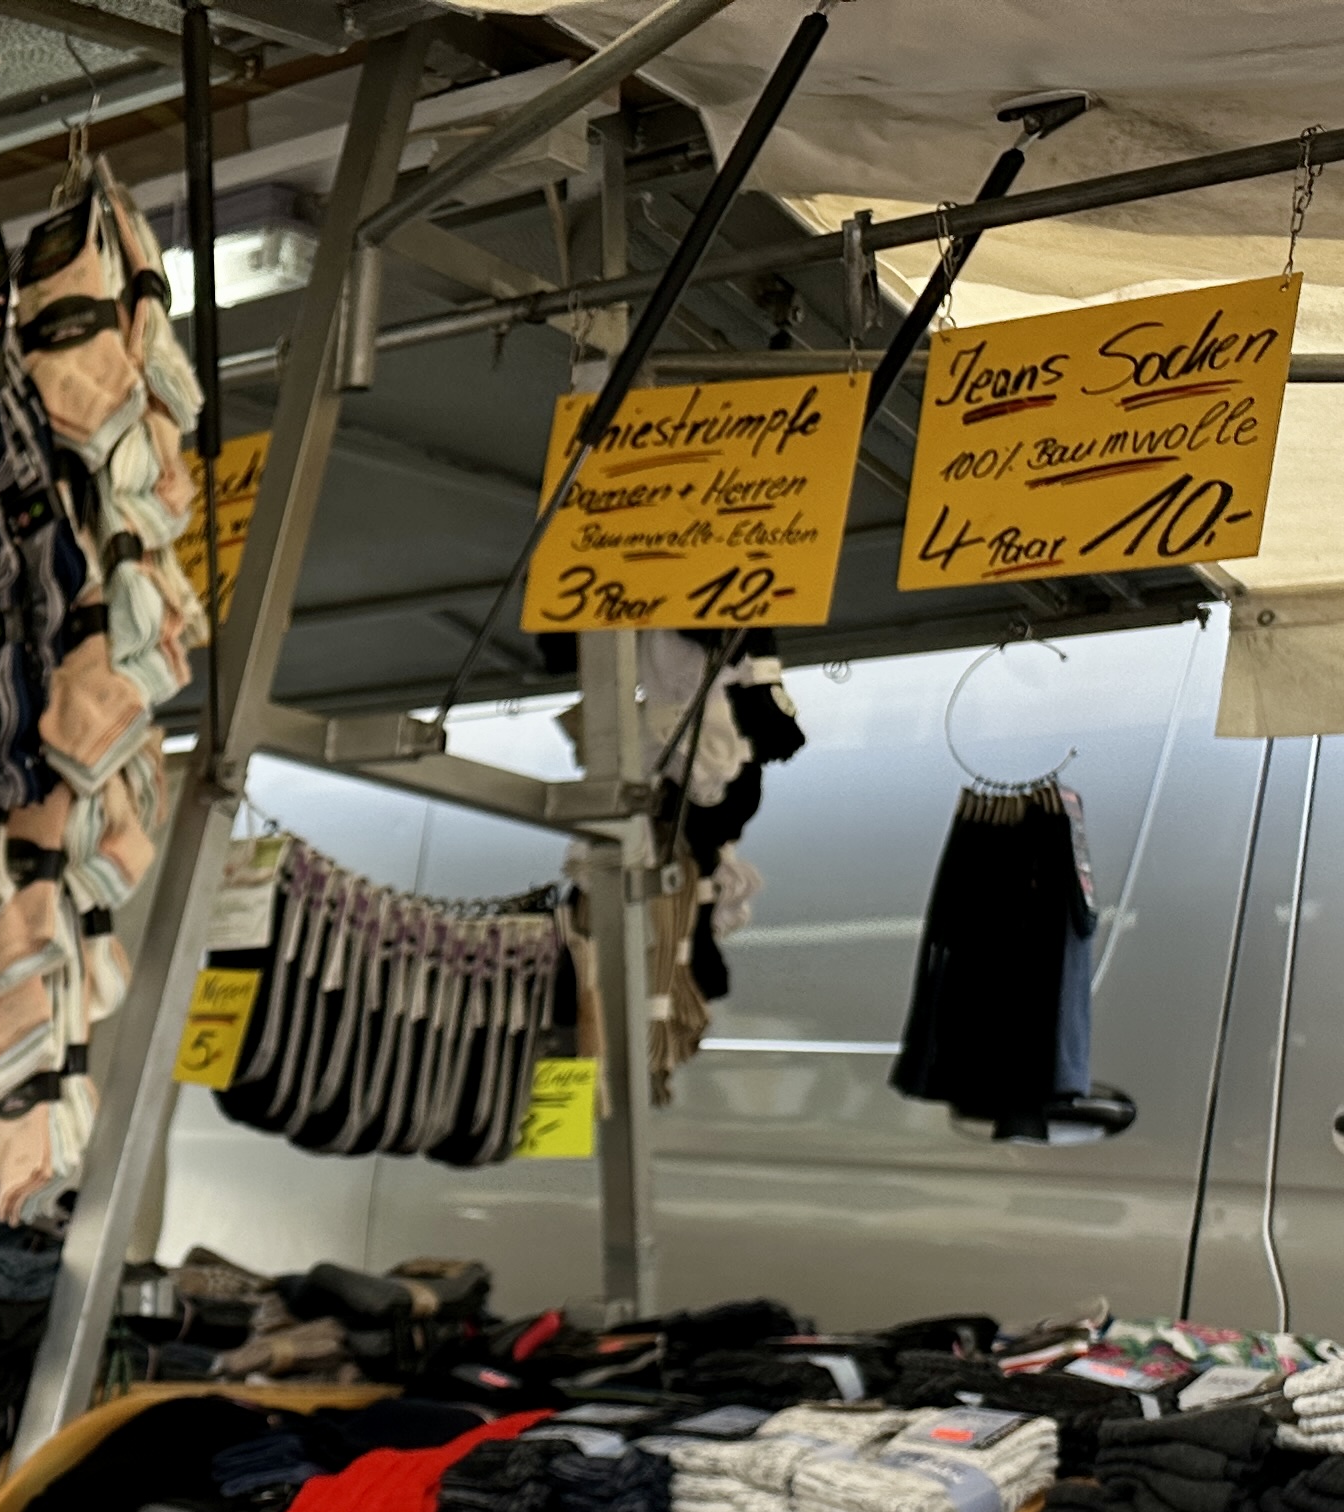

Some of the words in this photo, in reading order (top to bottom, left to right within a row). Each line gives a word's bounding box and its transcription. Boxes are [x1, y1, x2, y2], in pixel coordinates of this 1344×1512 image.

[935, 340, 1070, 406] Jeans
[1081, 310, 1277, 396] Socken
[564, 386, 822, 458] niestrümpfe
[940, 441, 1024, 482] 100%
[1027, 396, 1258, 470] Baumwolle
[562, 479, 669, 510] Damen
[702, 467, 808, 505] Herren
[918, 505, 985, 570] 4
[984, 526, 1066, 567] Paar
[541, 566, 595, 621] 3
[594, 582, 667, 622] Paar
